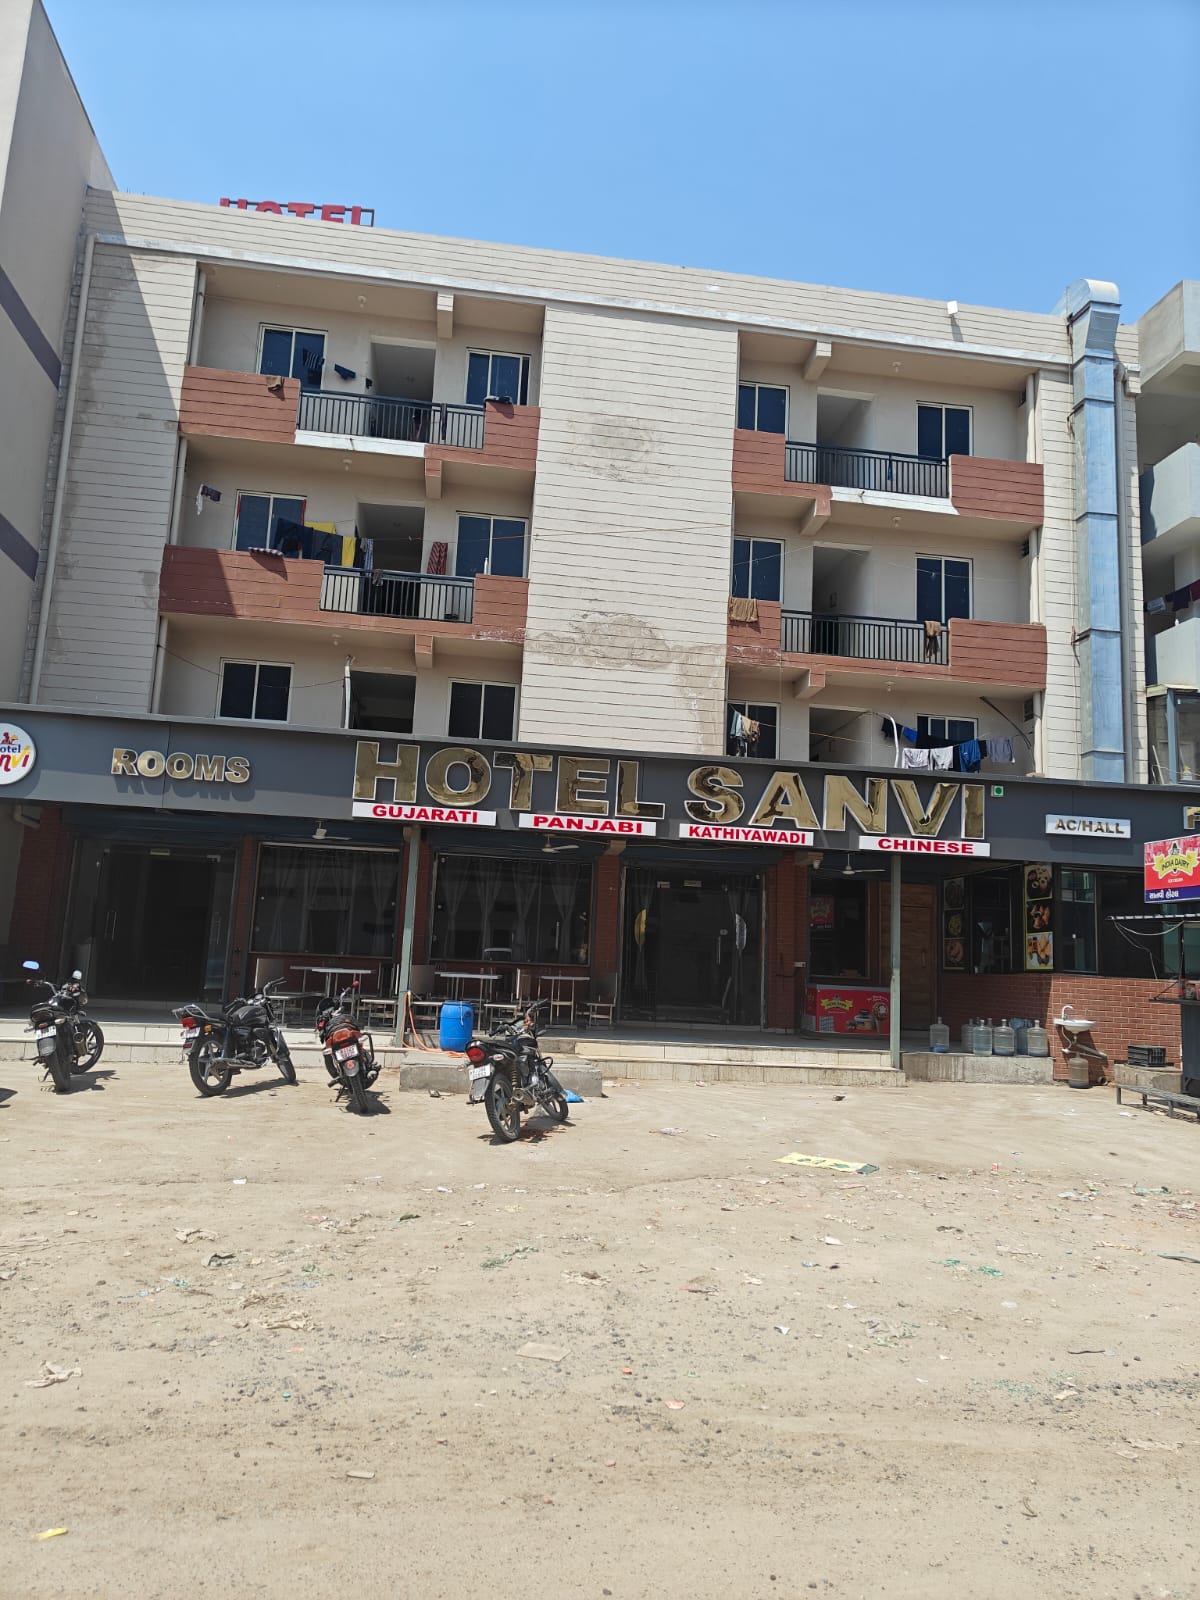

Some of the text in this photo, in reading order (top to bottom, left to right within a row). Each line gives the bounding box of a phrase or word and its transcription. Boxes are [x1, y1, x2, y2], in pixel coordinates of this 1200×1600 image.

[111, 747, 250, 783] ROOMS
[353, 741, 985, 839] HOTEL SANVI
[372, 804, 479, 823] GUJARATI
[532, 815, 643, 834] PANJABI
[1055, 819, 1125, 834] AC/HALL
[688, 825, 806, 844] KATHIYAWADI
[877, 838, 974, 854] CHINESE
